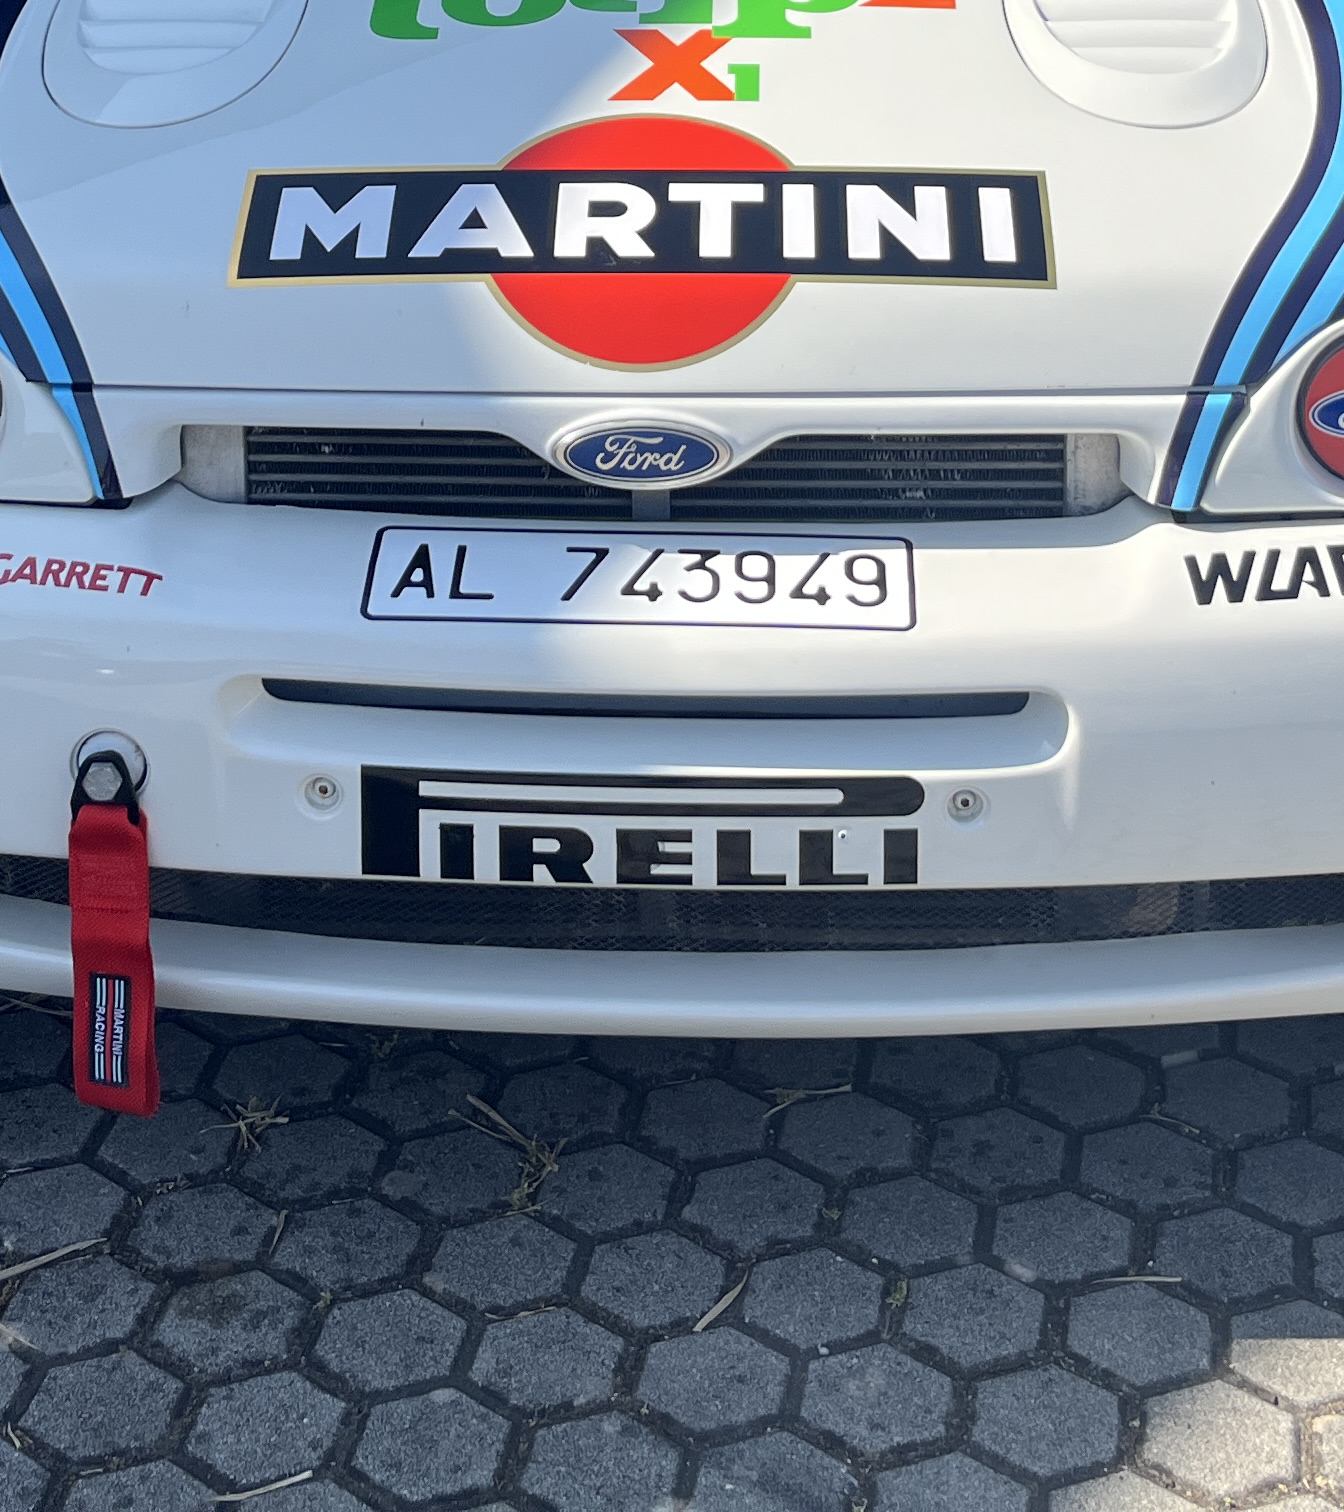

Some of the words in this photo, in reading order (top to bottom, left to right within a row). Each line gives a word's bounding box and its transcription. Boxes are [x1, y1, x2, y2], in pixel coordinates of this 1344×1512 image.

[268, 182, 1020, 262] MARTINI
[593, 435, 687, 473] Ford
[390, 543, 494, 600] AL
[560, 545, 889, 607] 743949
[360, 763, 925, 886] PIRELLI
[94, 1005, 106, 1054] RACING
[112, 1008, 125, 1057] MARTINI
